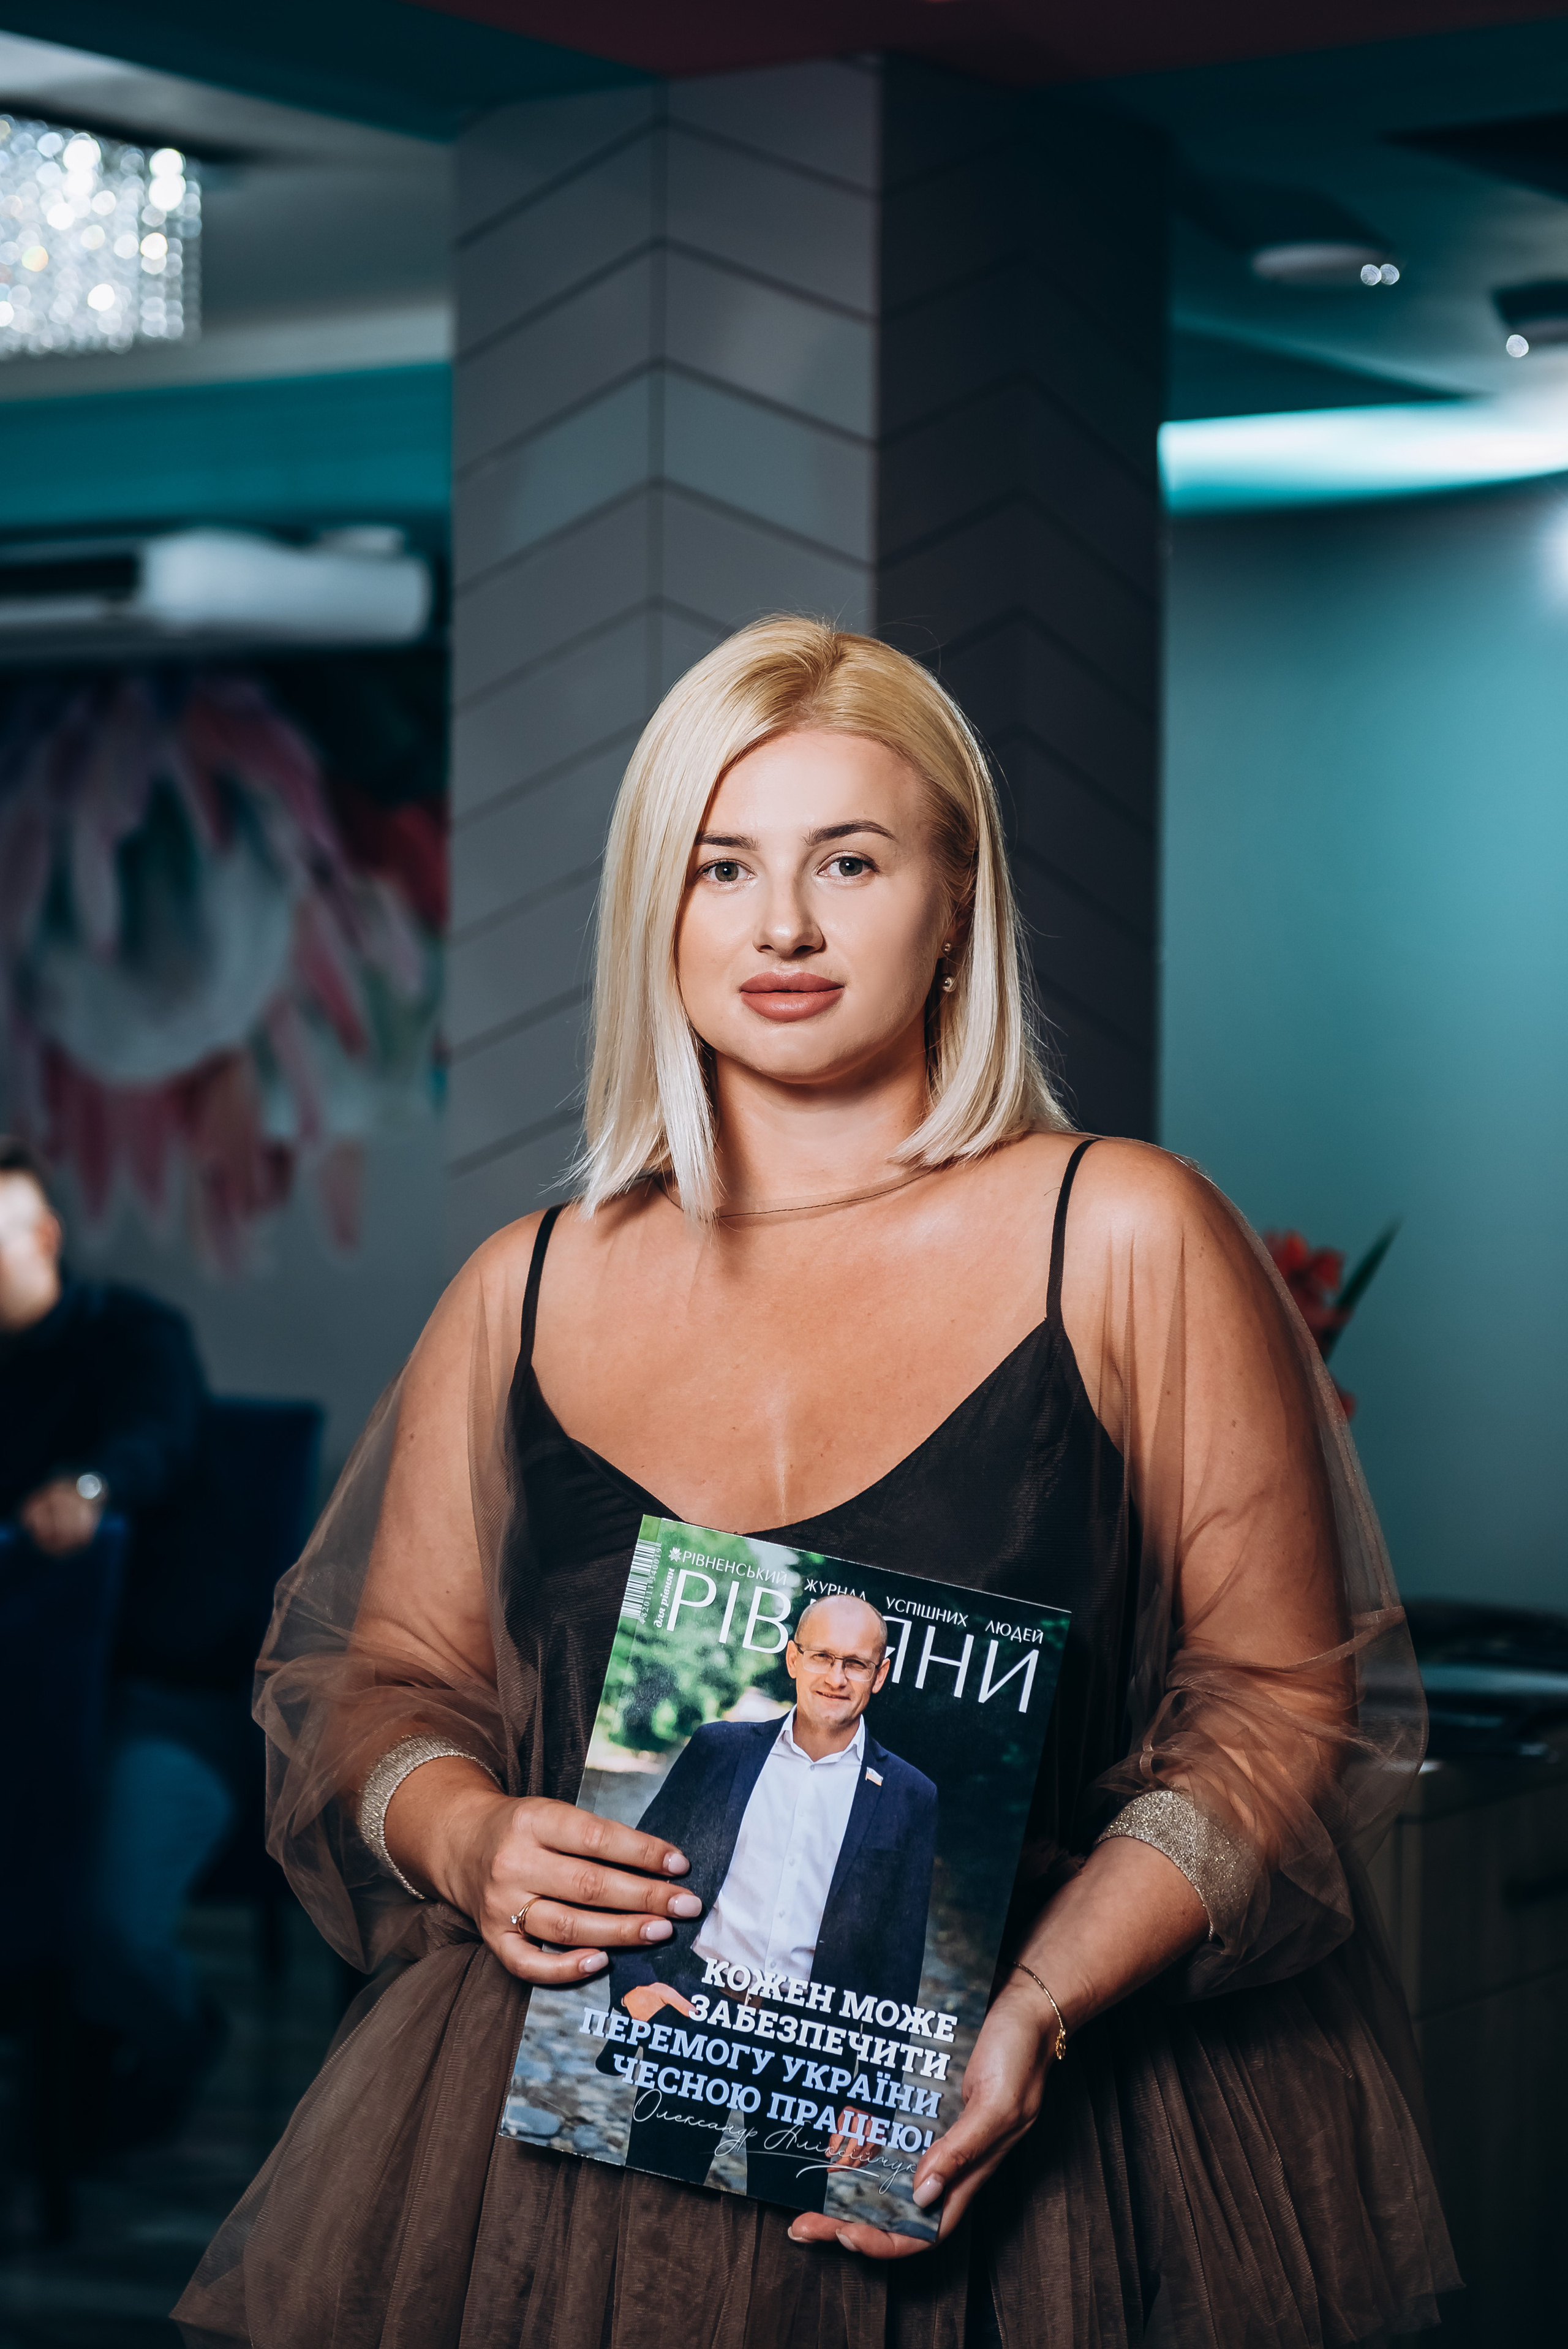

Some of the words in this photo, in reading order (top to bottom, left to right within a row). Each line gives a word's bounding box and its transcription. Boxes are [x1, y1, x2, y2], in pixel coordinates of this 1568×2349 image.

[666, 1568, 1039, 1713] РІВЯНИ
[682, 1550, 788, 1586] РІВНЕНСЬКИЙ
[886, 1596, 969, 1627] УСПІШНИХ
[985, 1620, 1044, 1644] ЛЮДЕЙ
[688, 1994, 951, 2081] ЗАБЕЗПЕЧИТИ
[701, 1957, 835, 2013] КОЖЕН
[839, 1989, 958, 2043] МОЖЕ
[579, 2007, 775, 2075] ПЕРЕМОГУ
[782, 2054, 942, 2119] УКРАЇНИ
[613, 2054, 761, 2113] ЧЕСНОЮ
[767, 2092, 933, 2155] ПРАЦЕЮ!
[633, 2089, 758, 2157] Олександр
